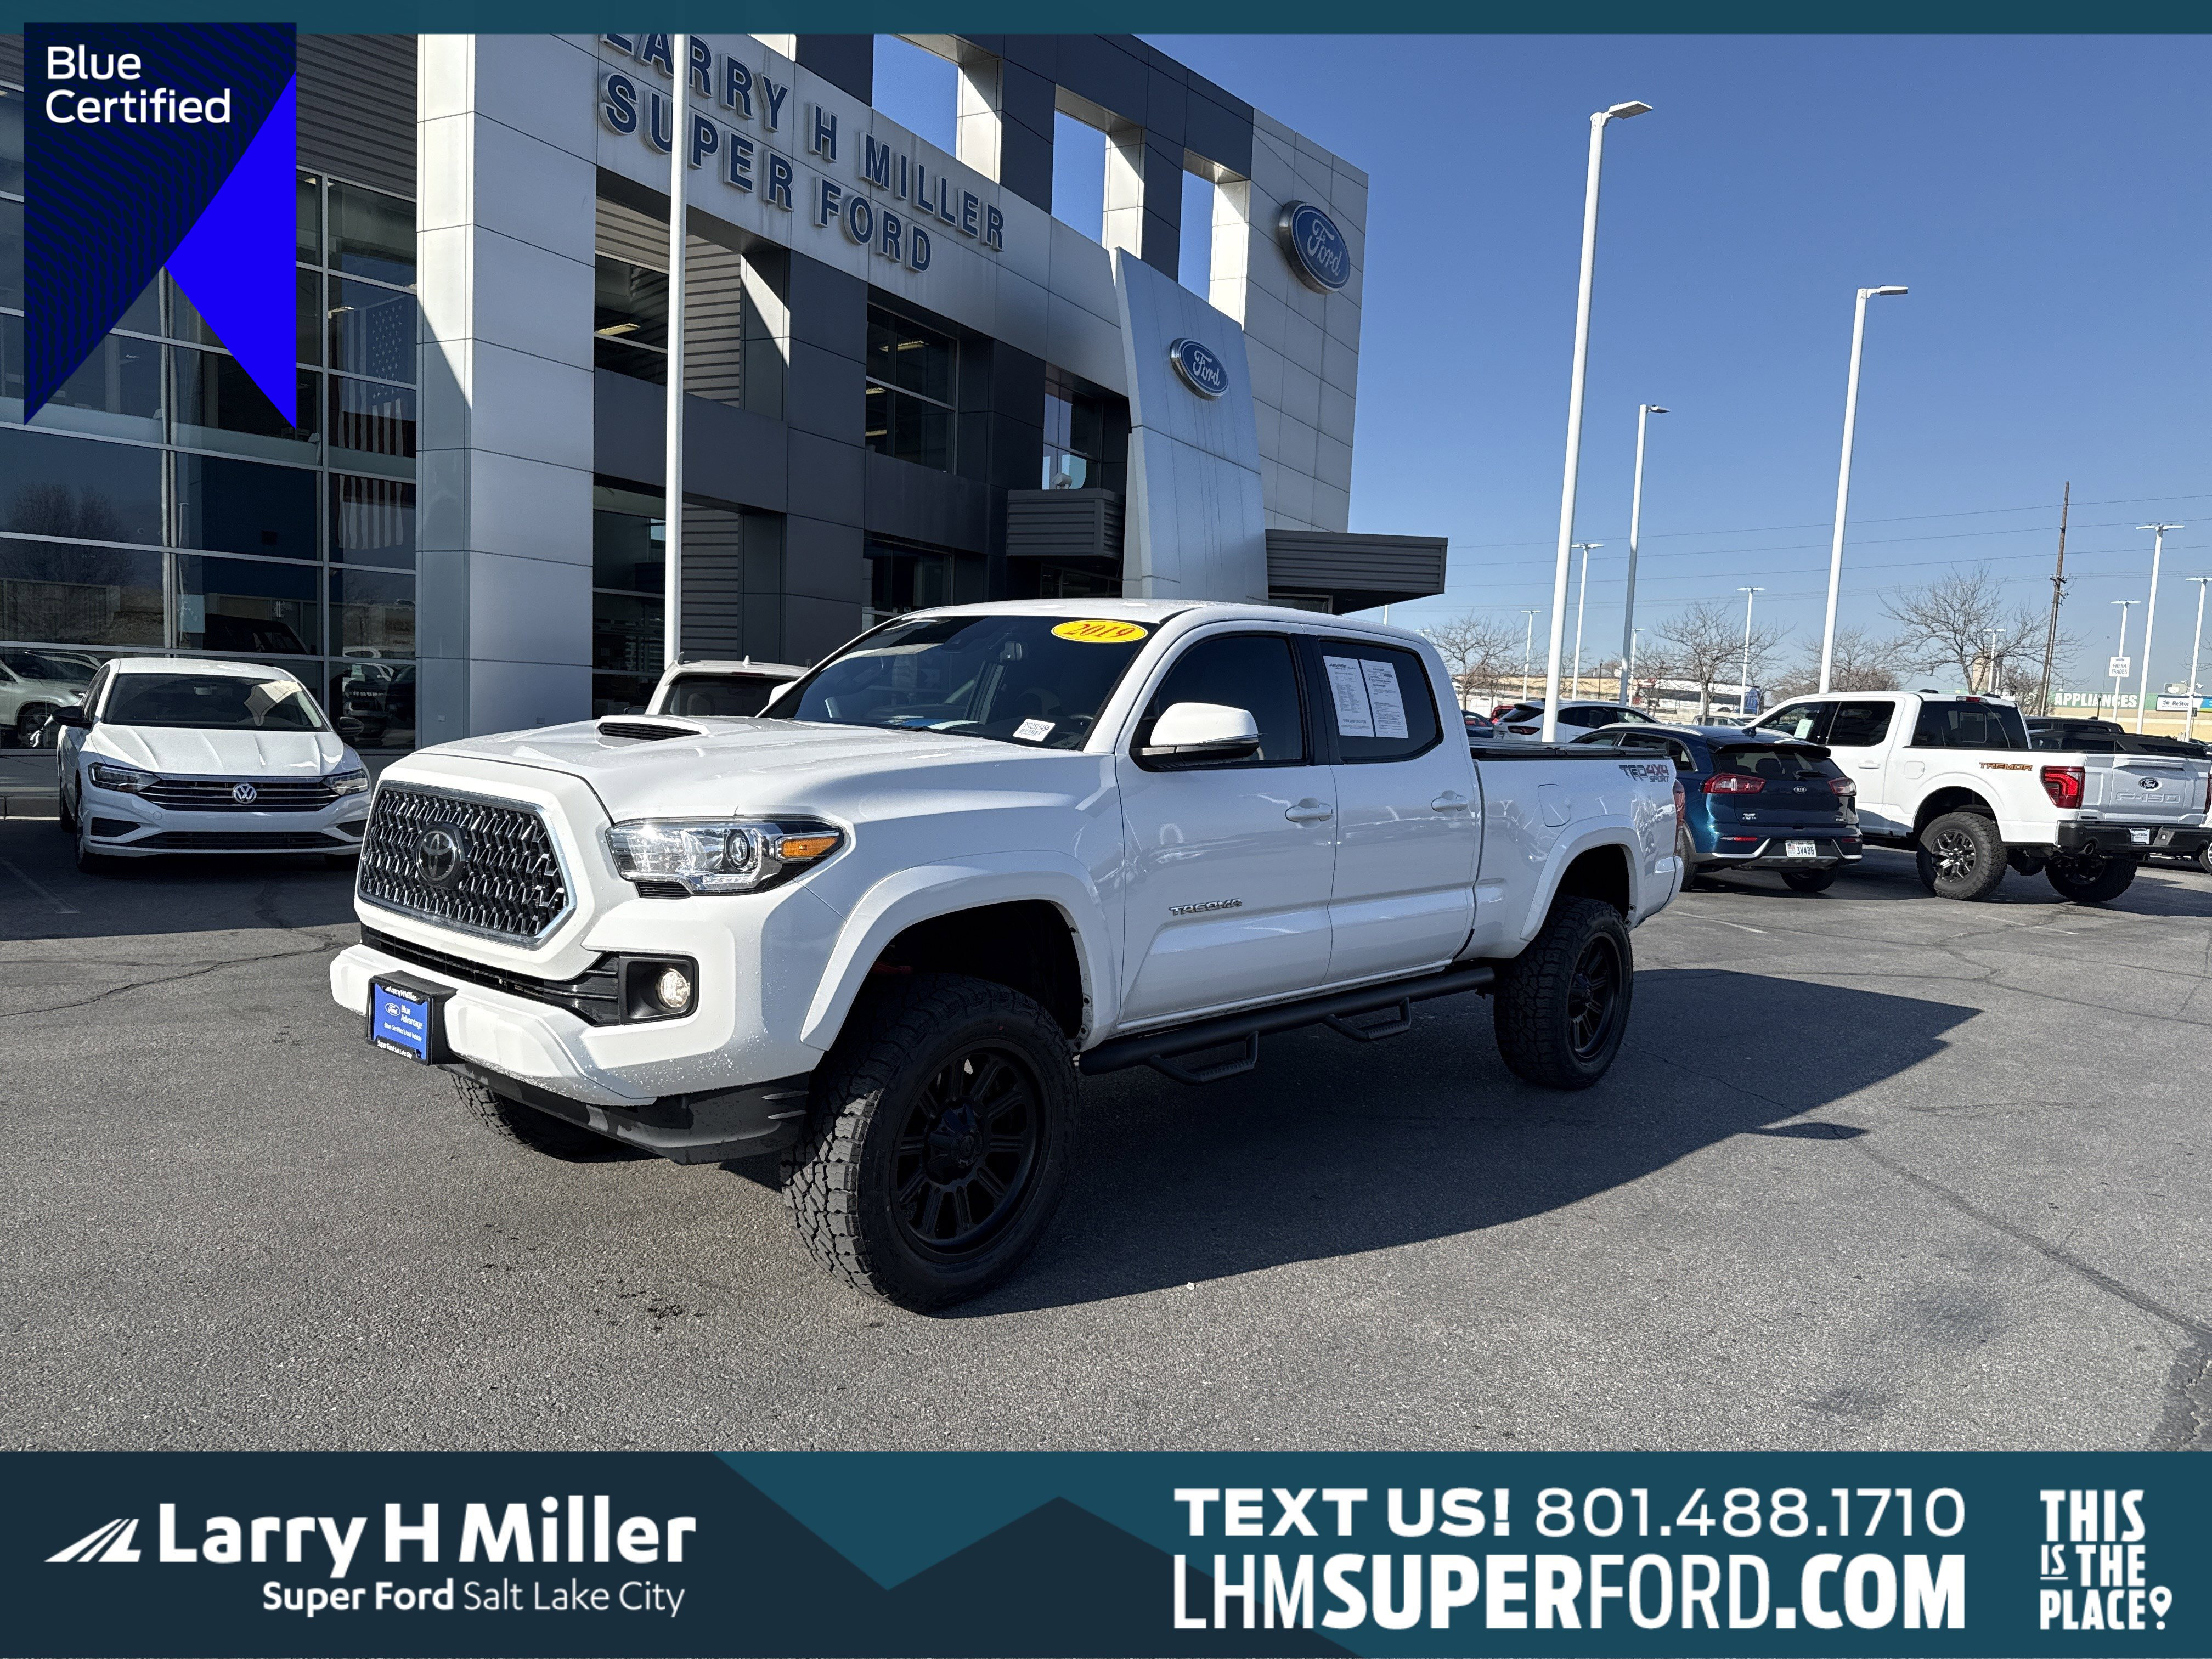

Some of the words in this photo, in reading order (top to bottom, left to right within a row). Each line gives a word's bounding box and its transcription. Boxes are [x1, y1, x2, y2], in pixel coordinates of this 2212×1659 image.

[599, 72, 794, 212] SUPER
[814, 176, 932, 273] FORD
[808, 102, 838, 163] H
[859, 131, 1005, 252] MILLER
[1306, 218, 1342, 277] Ford
[1192, 349, 1221, 387] Ford
[1062, 624, 1136, 639] 2019
[2054, 692, 2137, 708] APPLIANCES
[1618, 764, 1648, 782] TRD
[1978, 761, 2033, 771] TREMOR
[2143, 779, 2157, 788] Ford
[2115, 792, 2181, 804] F-150
[1168, 898, 1243, 916] TACOMA
[401, 1005, 411, 1015] Blue
[400, 1014, 423, 1030] Advantage
